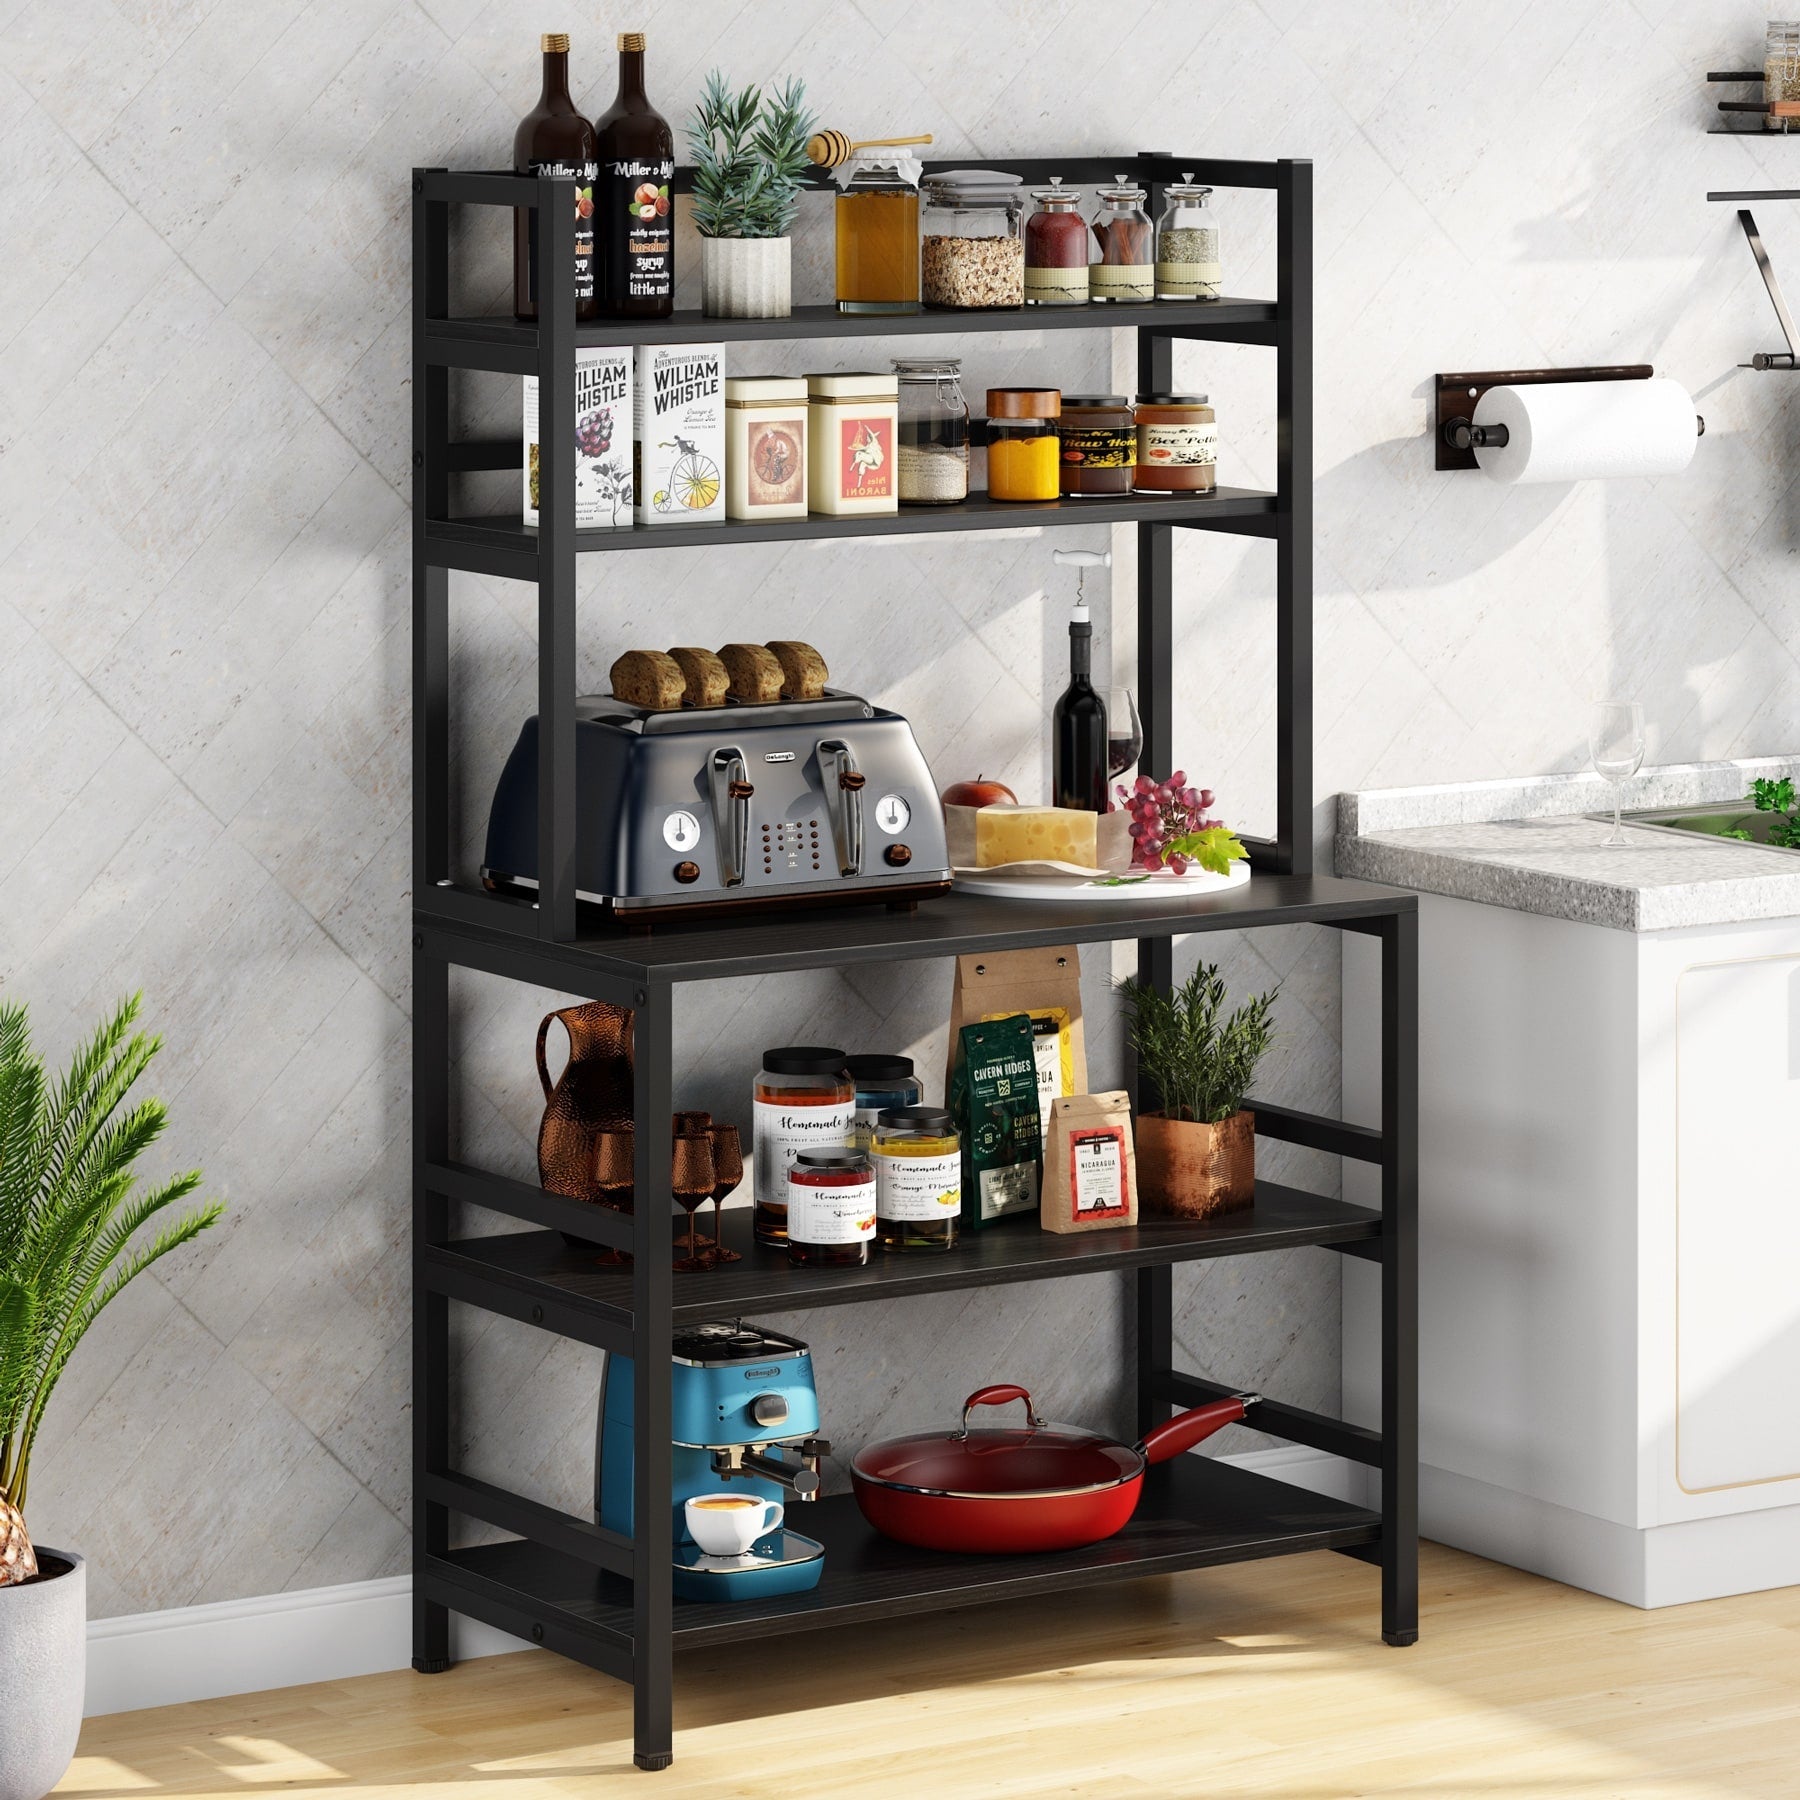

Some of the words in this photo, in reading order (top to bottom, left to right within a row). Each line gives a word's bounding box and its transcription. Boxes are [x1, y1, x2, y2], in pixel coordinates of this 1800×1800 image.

[537, 163, 575, 176] Miller
[612, 161, 652, 178] Miller
[629, 239, 670, 253] hazelnut
[636, 257, 664, 271] syrup
[580, 284, 593, 297] nut
[629, 282, 656, 295] little
[656, 282, 670, 295] nut
[576, 365, 626, 391] ILLIAM
[654, 361, 719, 392] WILLIAM
[577, 382, 626, 414] HISTLE
[654, 378, 719, 416] WHISTLE
[1148, 436, 1180, 444] Bee
[974, 1064, 1004, 1082] CAVERN
[778, 1115, 841, 1130] Homemade
[1014, 1113, 1038, 1128] CAVERN
[1014, 1124, 1039, 1140] RIDGES
[889, 1162, 946, 1173] Homemade
[1081, 1160, 1115, 1169] NICARAGUA
